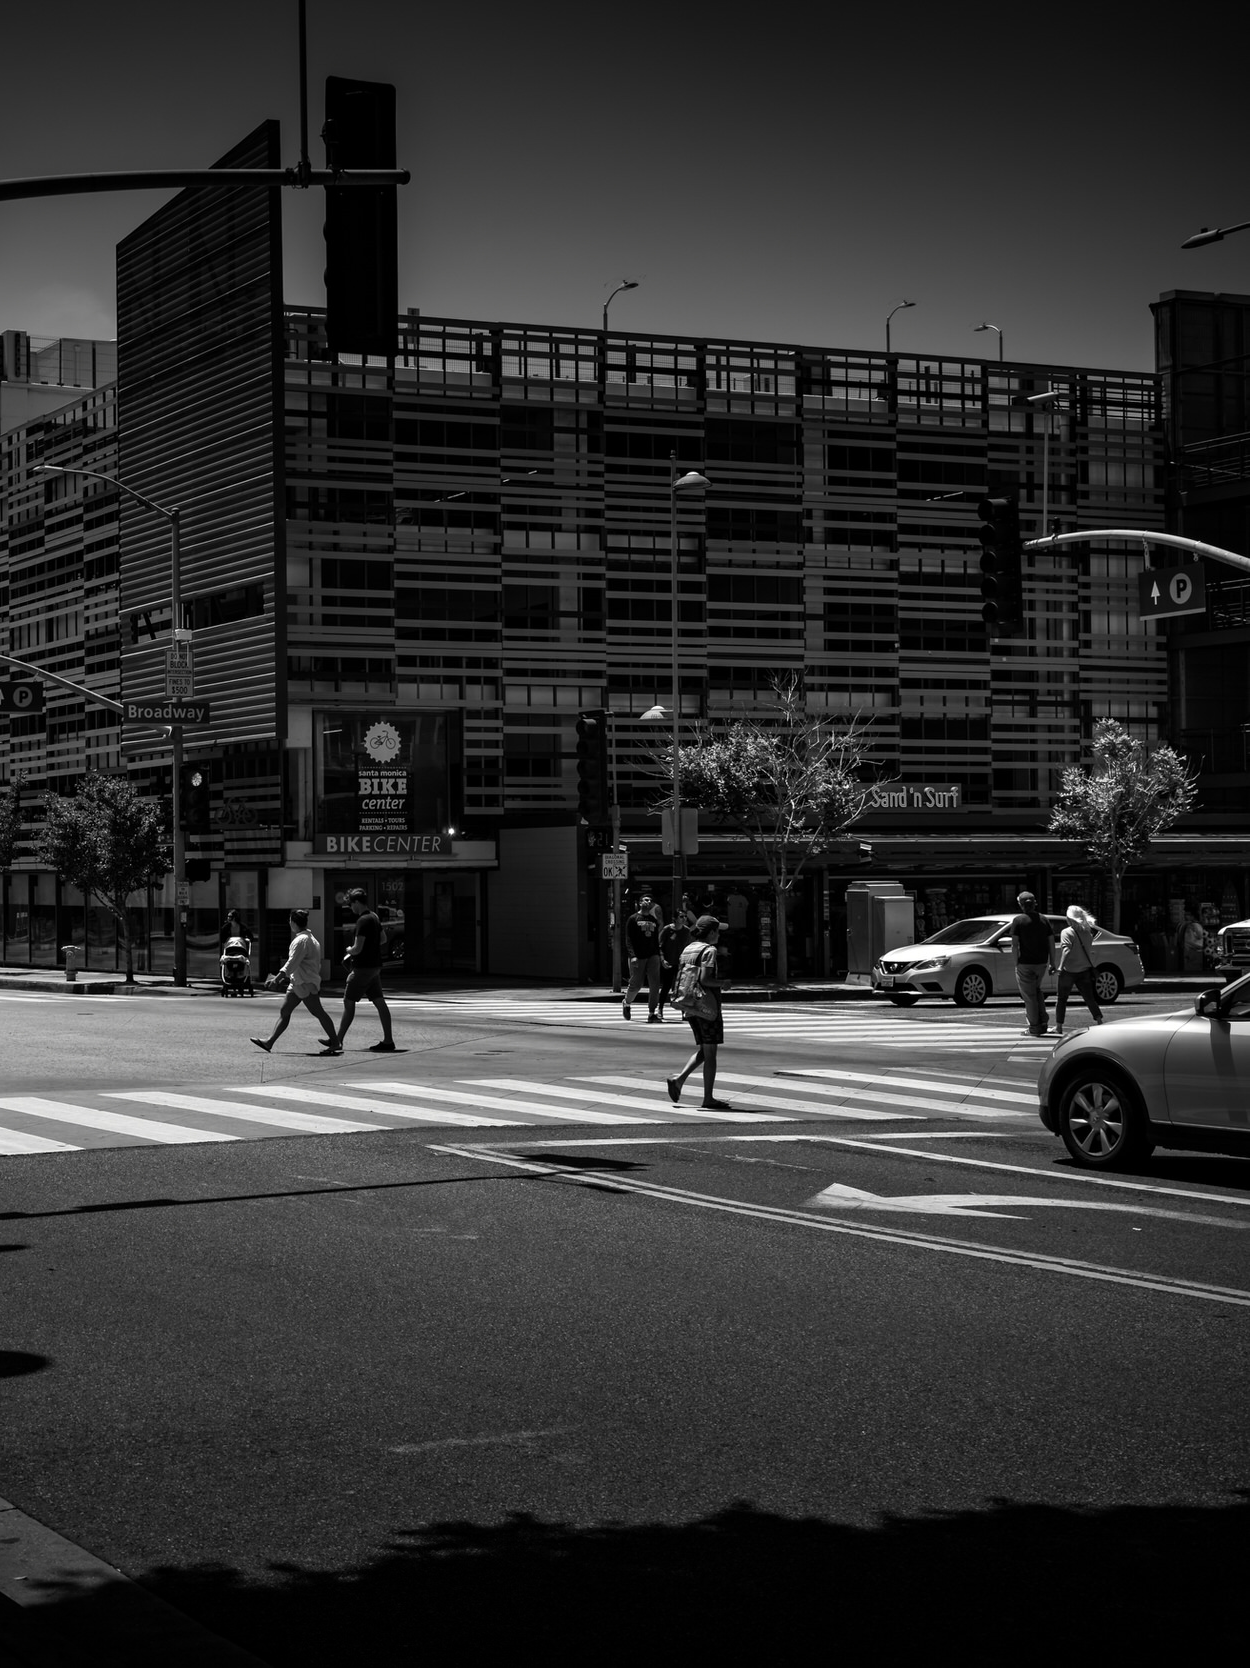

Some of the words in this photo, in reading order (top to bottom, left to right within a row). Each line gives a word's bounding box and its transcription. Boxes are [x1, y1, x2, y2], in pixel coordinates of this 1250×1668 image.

[1176, 579, 1188, 599] P
[170, 660, 190, 669] BLOCK
[169, 678, 183, 686] FINES
[184, 678, 191, 686] TO
[19, 690, 29, 703] P
[172, 686, 188, 695] $500
[128, 703, 205, 723] Broadway
[358, 778, 407, 795] BIKE
[361, 796, 406, 810] center
[871, 785, 908, 808] Sand
[923, 786, 959, 808] Surf
[603, 867, 613, 877] OK
[381, 881, 404, 891] 1502
